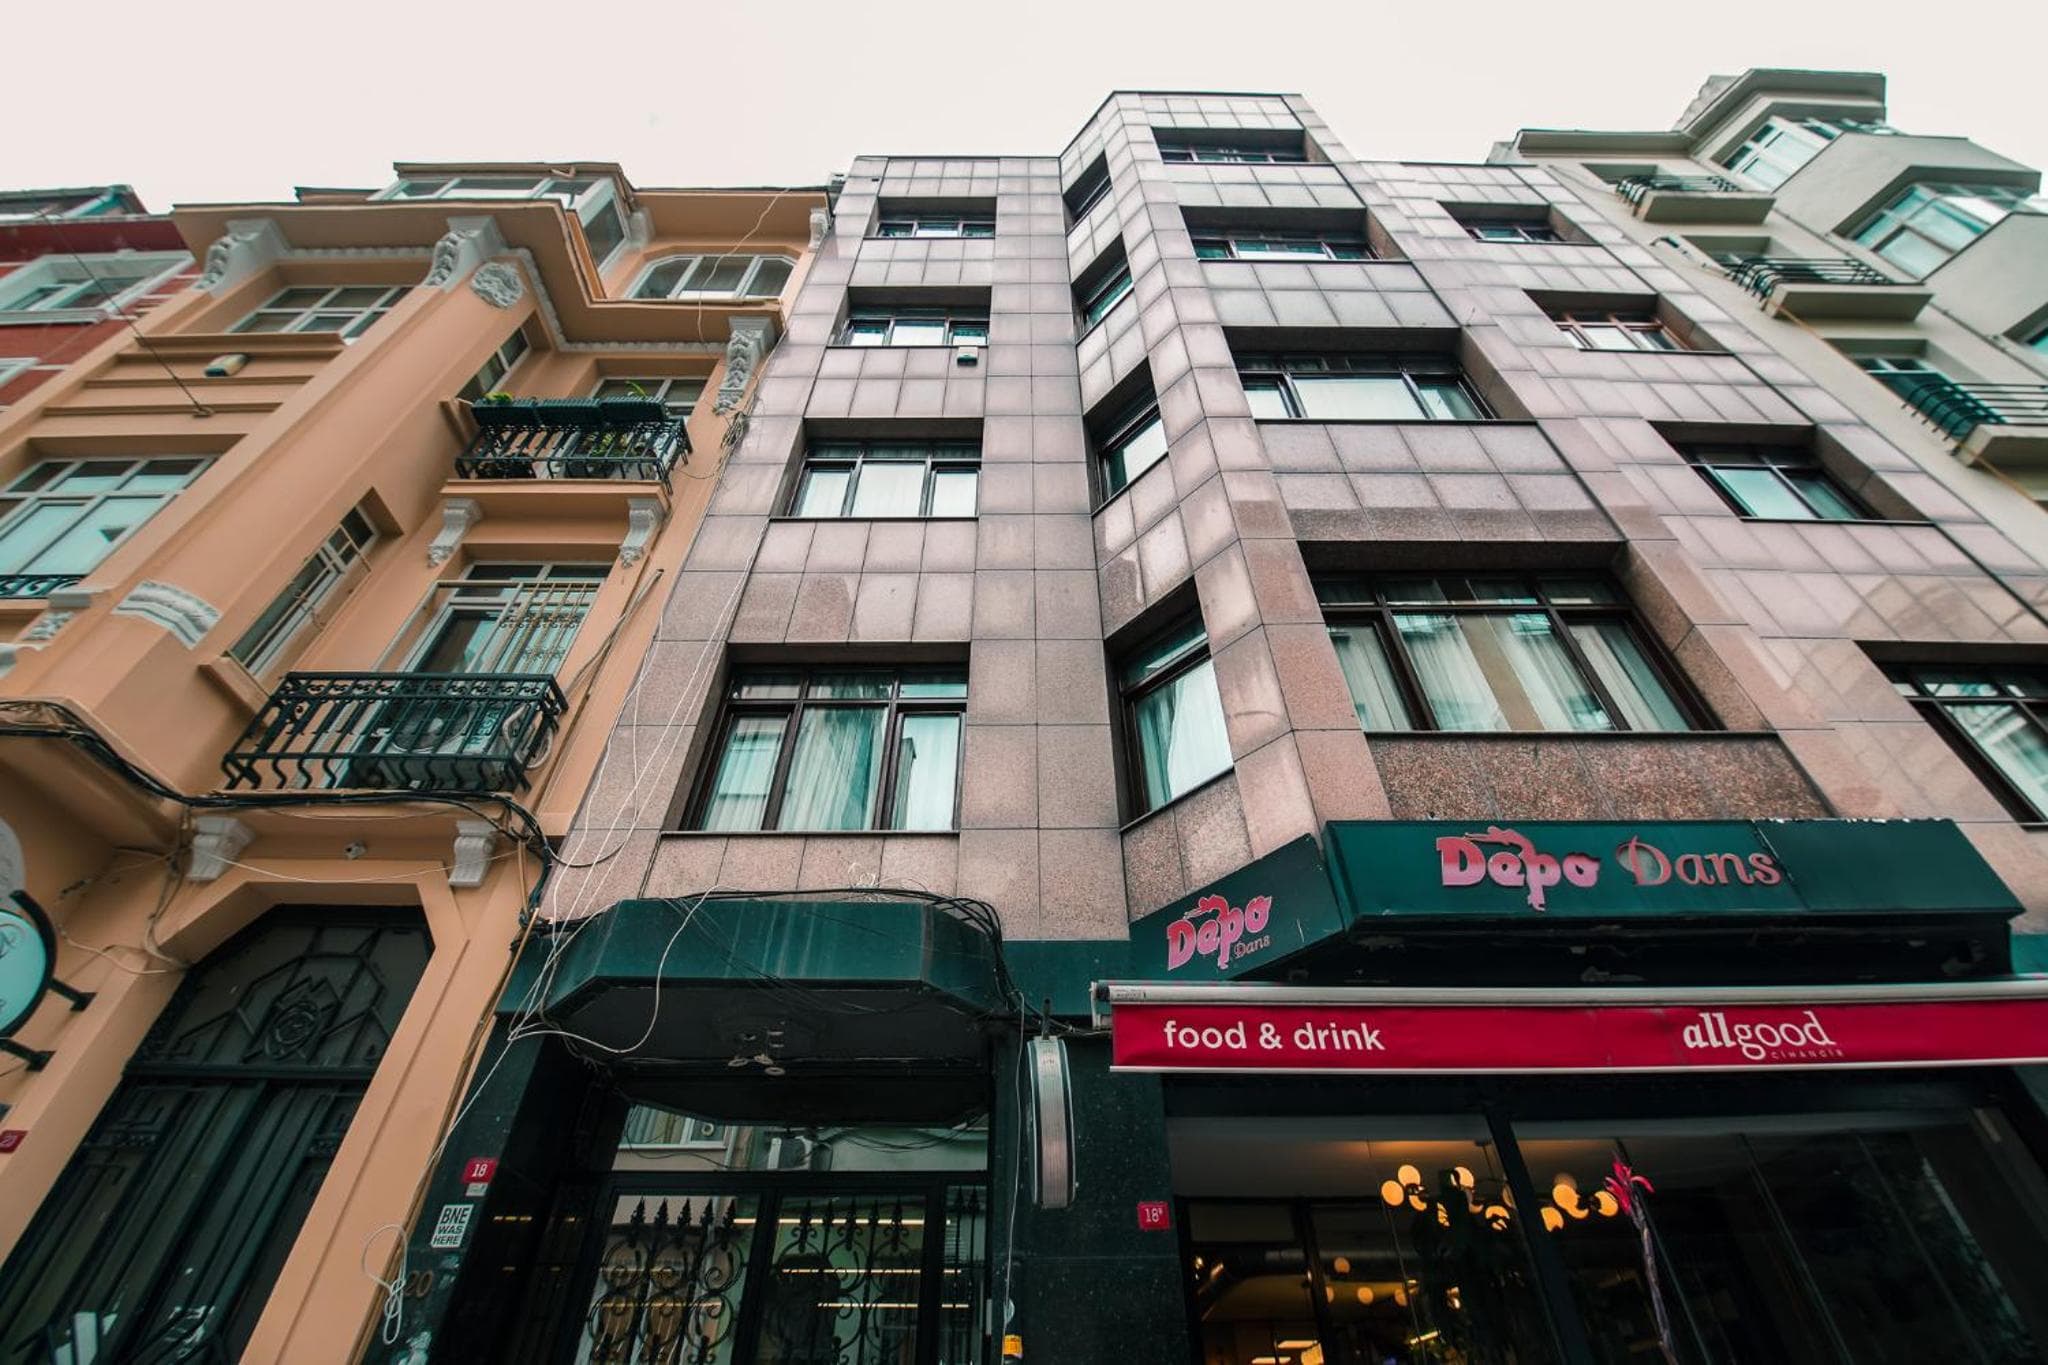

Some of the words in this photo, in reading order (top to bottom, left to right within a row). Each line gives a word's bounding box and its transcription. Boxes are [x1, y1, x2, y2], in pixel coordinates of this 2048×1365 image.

[1436, 826, 1600, 912] Depo
[1616, 835, 1783, 886] Dans
[1166, 894, 1273, 971] Depo
[1234, 934, 1271, 959] Dans
[1163, 1020, 1247, 1050] food
[1259, 1021, 1283, 1049] &
[1293, 1021, 1386, 1050] drink
[472, 1163, 488, 1178] 18
[441, 1207, 471, 1224] BNE
[433, 1235, 460, 1245] HERE
[437, 1225, 464, 1234] WAS
[405, 1270, 433, 1297] 20
